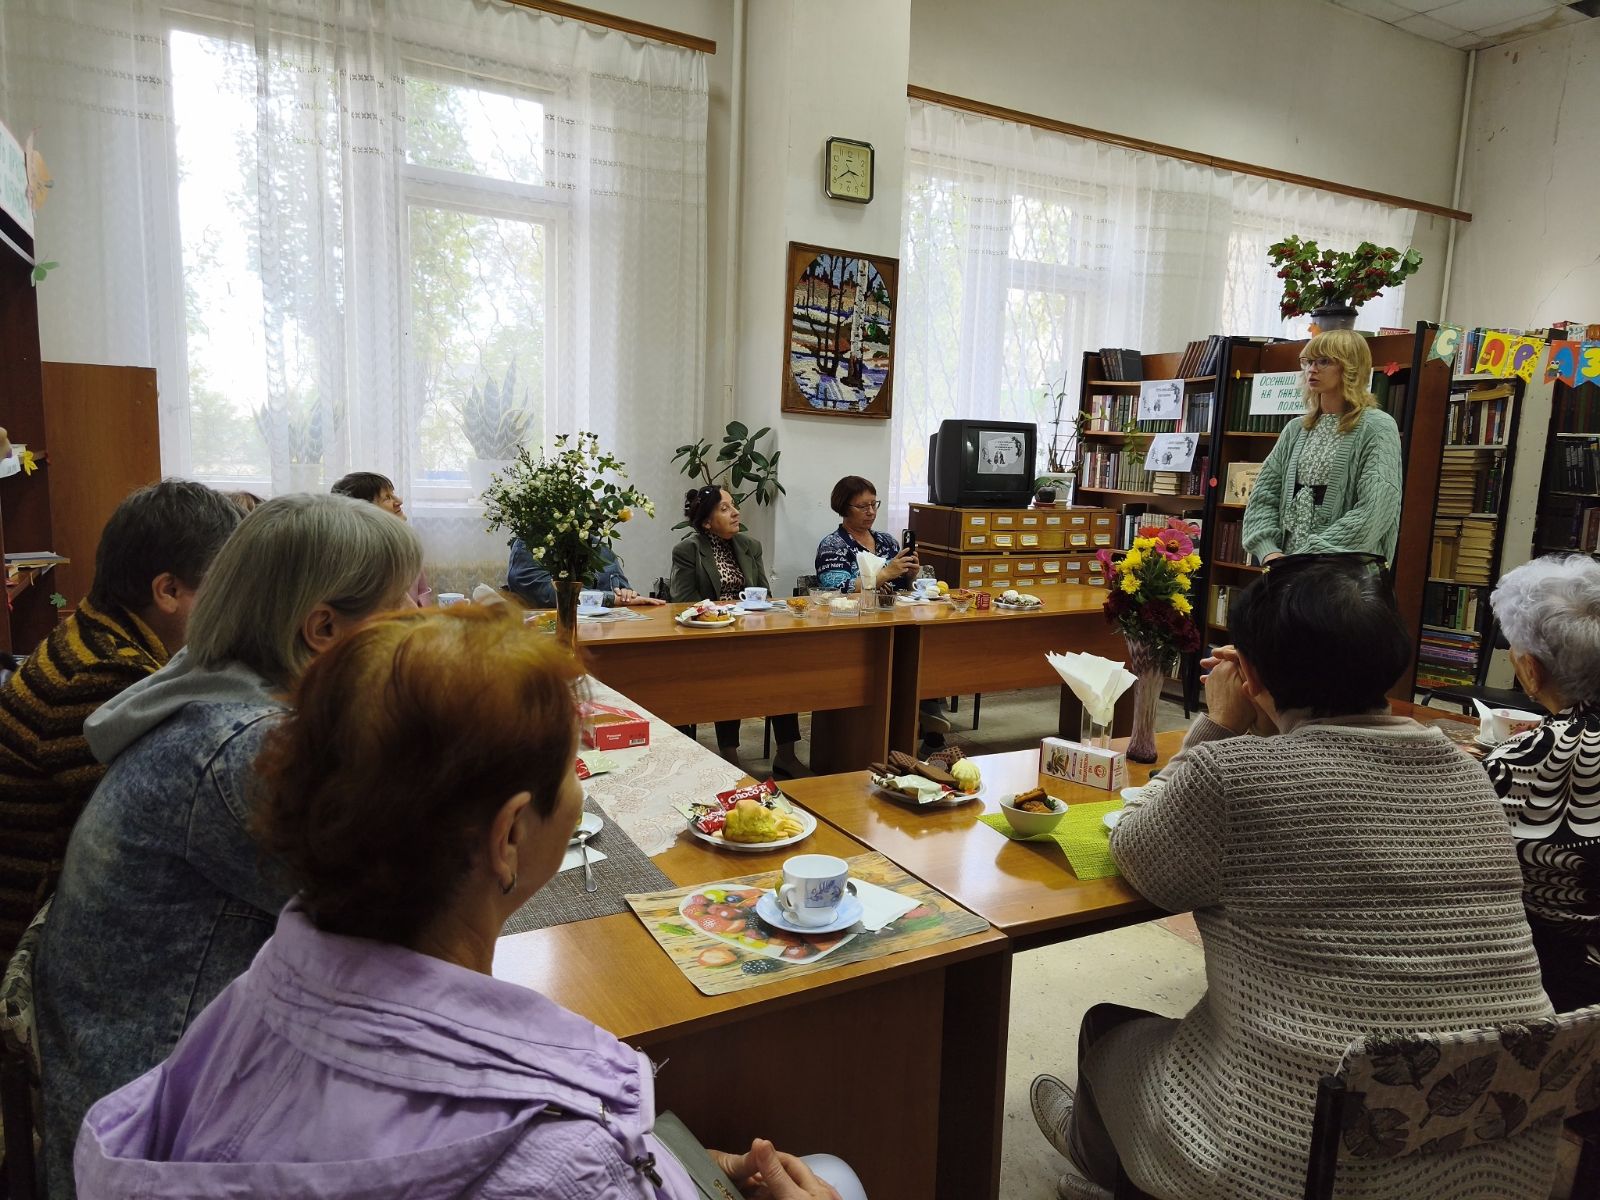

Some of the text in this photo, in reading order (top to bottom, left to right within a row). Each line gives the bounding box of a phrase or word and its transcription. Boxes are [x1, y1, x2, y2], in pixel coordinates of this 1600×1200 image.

[1436, 329, 1457, 356] С
[1260, 374, 1296, 386] ОСЕННИЙ
[1261, 389, 1272, 399] НА
[1278, 401, 1305, 411] ПОЛЯН
[728, 784, 768, 803] Choco-Pi
